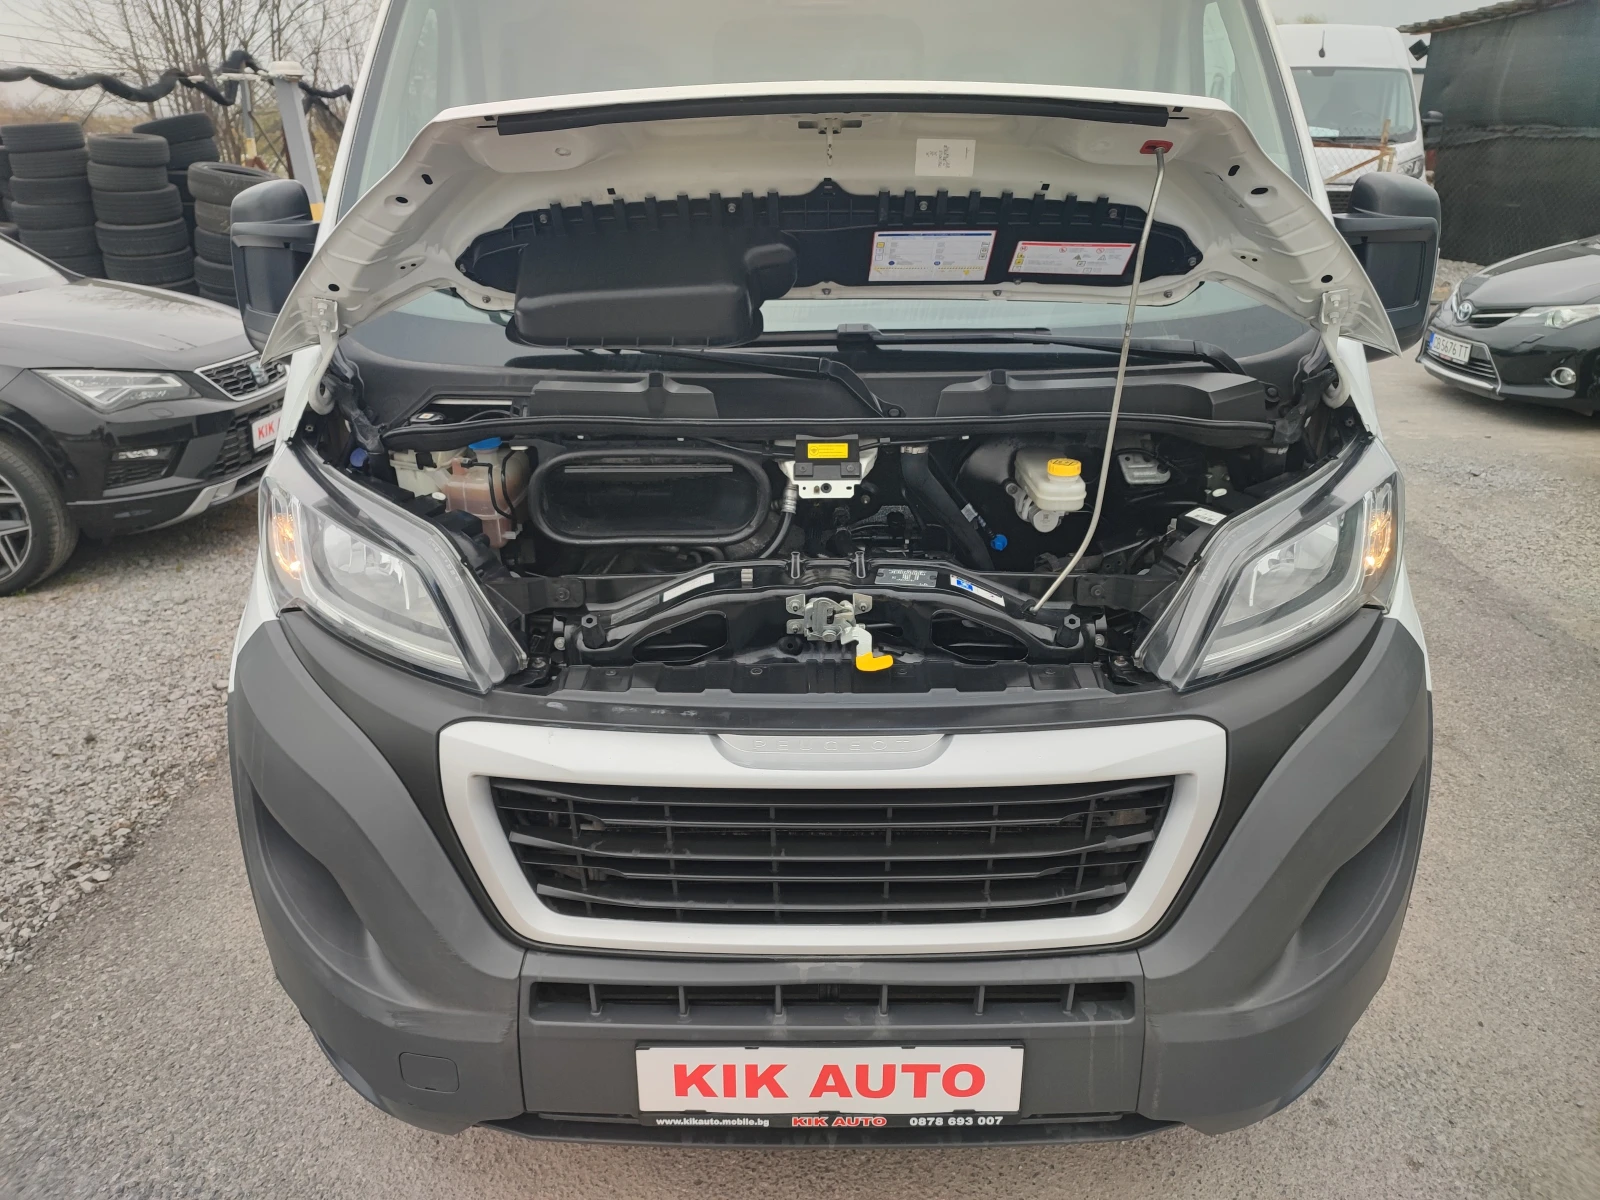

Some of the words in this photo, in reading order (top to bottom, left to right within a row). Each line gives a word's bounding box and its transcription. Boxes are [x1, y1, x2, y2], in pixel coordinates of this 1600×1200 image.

[257, 422, 275, 440] KIK
[752, 739, 911, 751] PEUGEOT
[673, 1063, 789, 1099] KIK
[809, 1063, 986, 1099] AUTO
[655, 1116, 770, 1127] www.kikauto.mobile.bg
[791, 1116, 830, 1127] KIK
[832, 1116, 888, 1127] AUTO
[909, 1116, 944, 1127] 0878
[948, 1116, 974, 1126] 693
[977, 1115, 1004, 1126] 007
